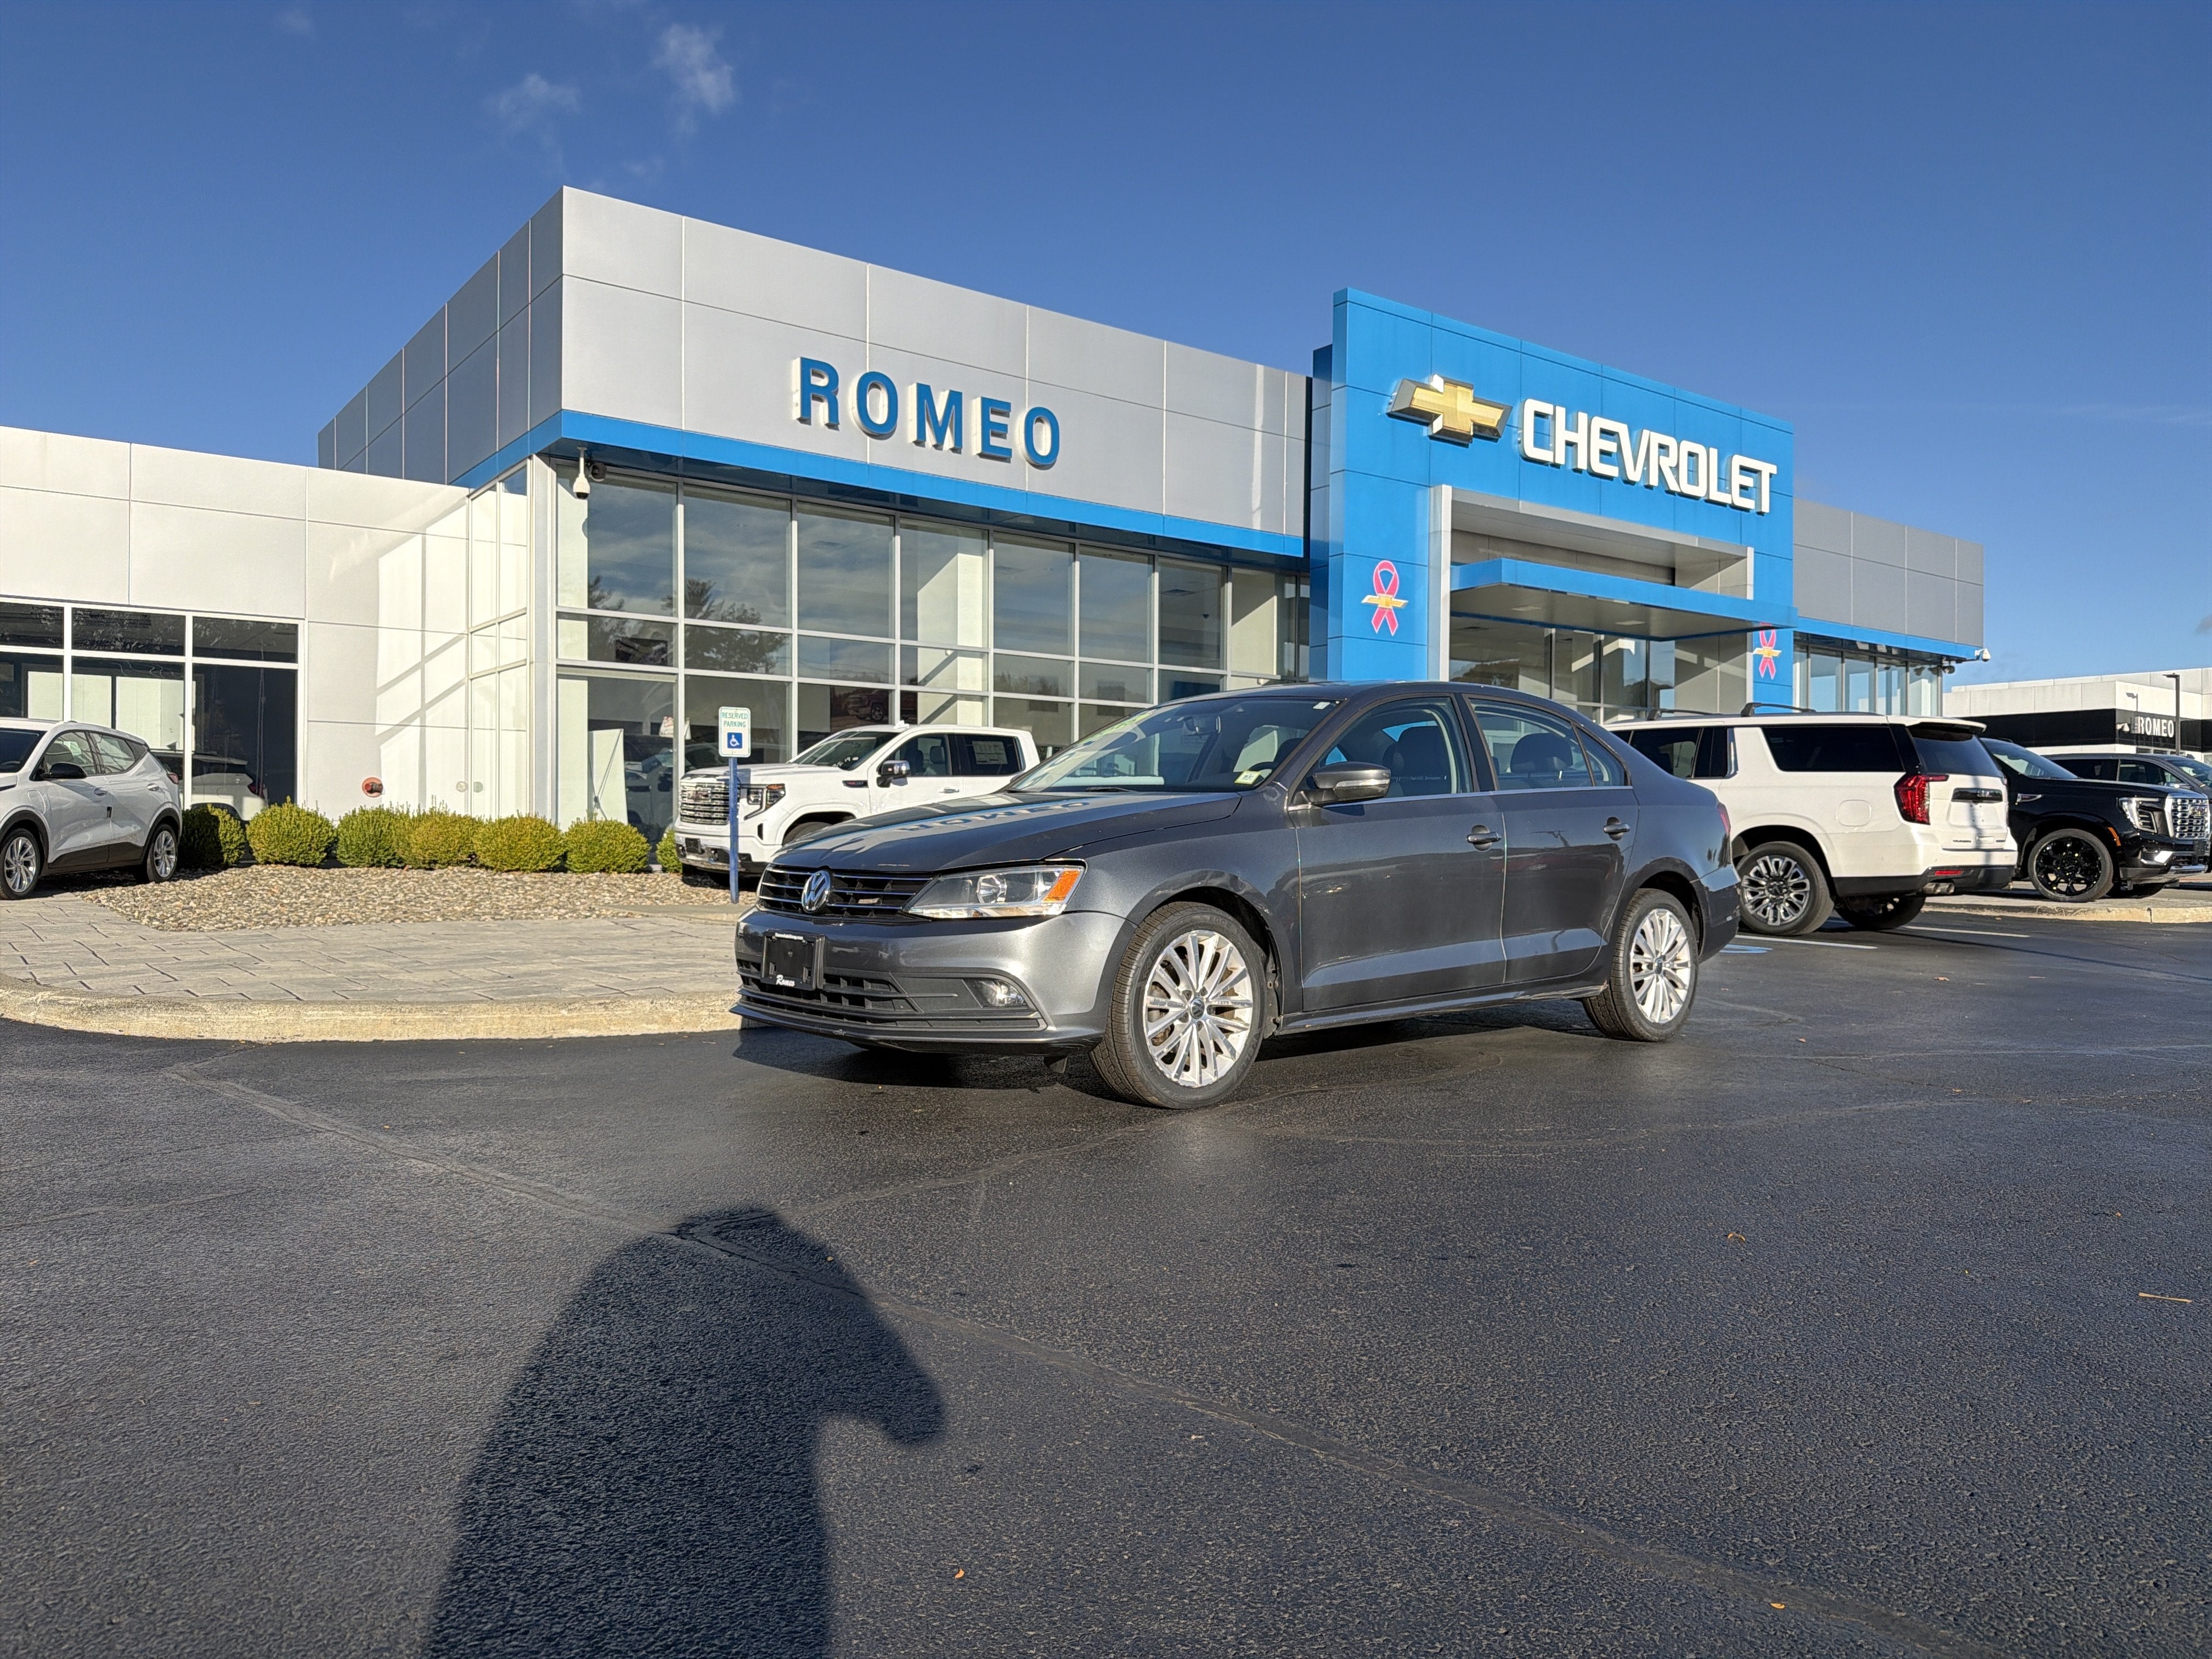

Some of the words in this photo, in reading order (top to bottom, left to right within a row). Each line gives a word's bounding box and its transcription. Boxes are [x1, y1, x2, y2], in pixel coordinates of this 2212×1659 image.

[793, 357, 1060, 467] ROMEO
[1520, 398, 1778, 515] CHEVROLET
[723, 720, 747, 728] PARKING
[2137, 716, 2174, 738] ROMEO
[775, 974, 795, 988] Romeo
